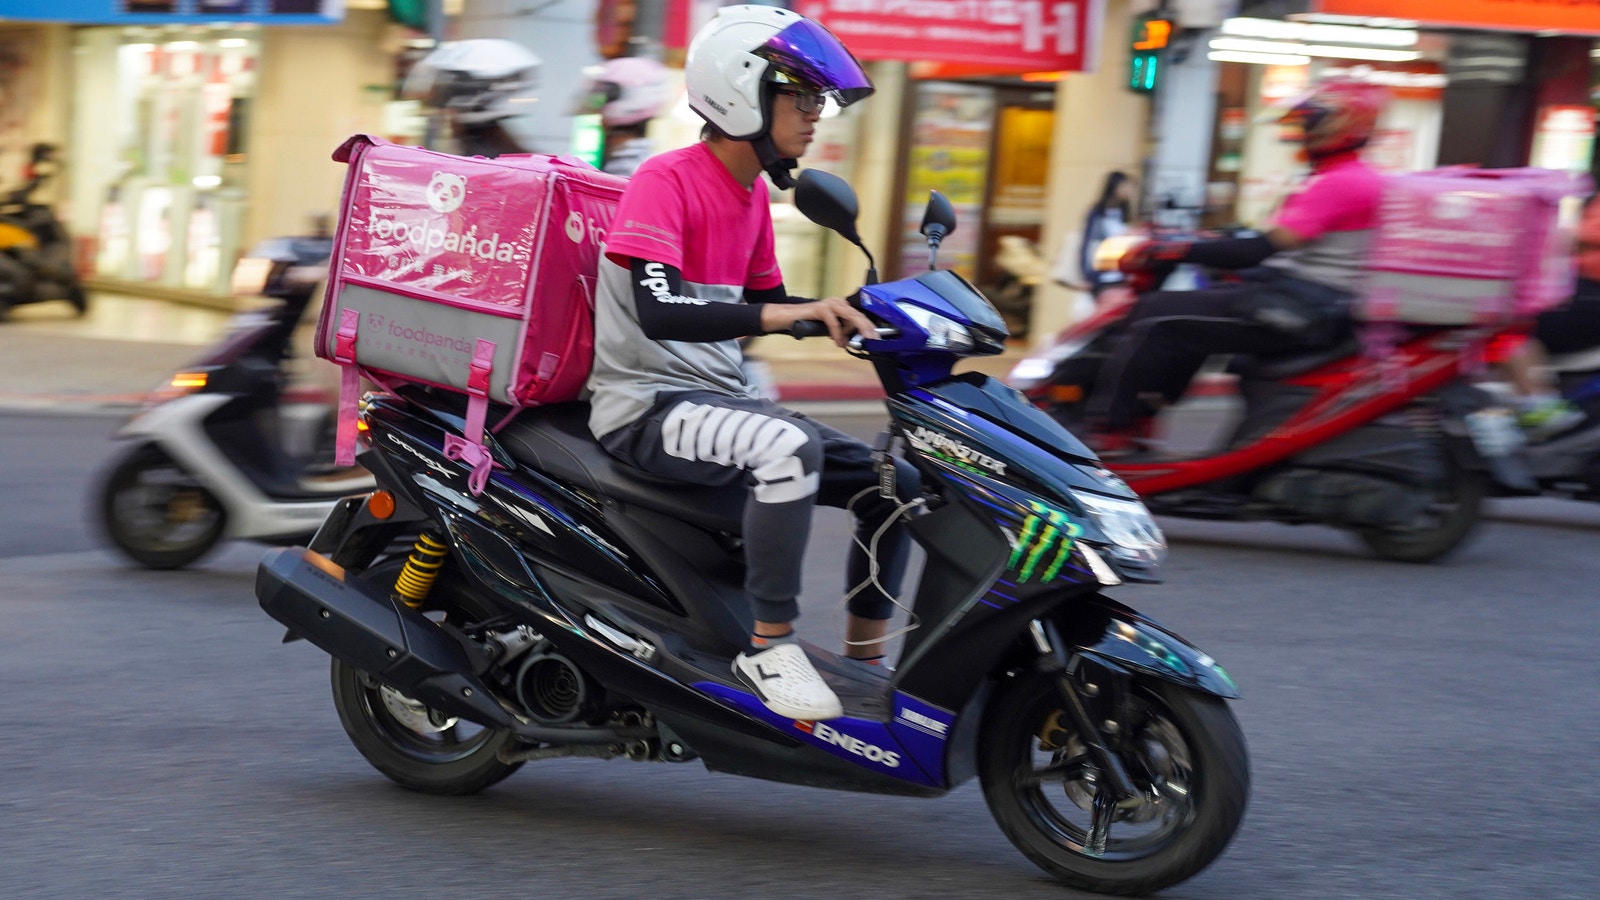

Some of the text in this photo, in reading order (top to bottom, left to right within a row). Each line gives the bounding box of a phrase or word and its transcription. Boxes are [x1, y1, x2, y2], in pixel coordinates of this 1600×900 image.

[368, 210, 514, 263] foodpanda
[389, 320, 472, 354] foodpanda
[914, 426, 1007, 476] MONSTER
[812, 721, 901, 768] ENEOS
